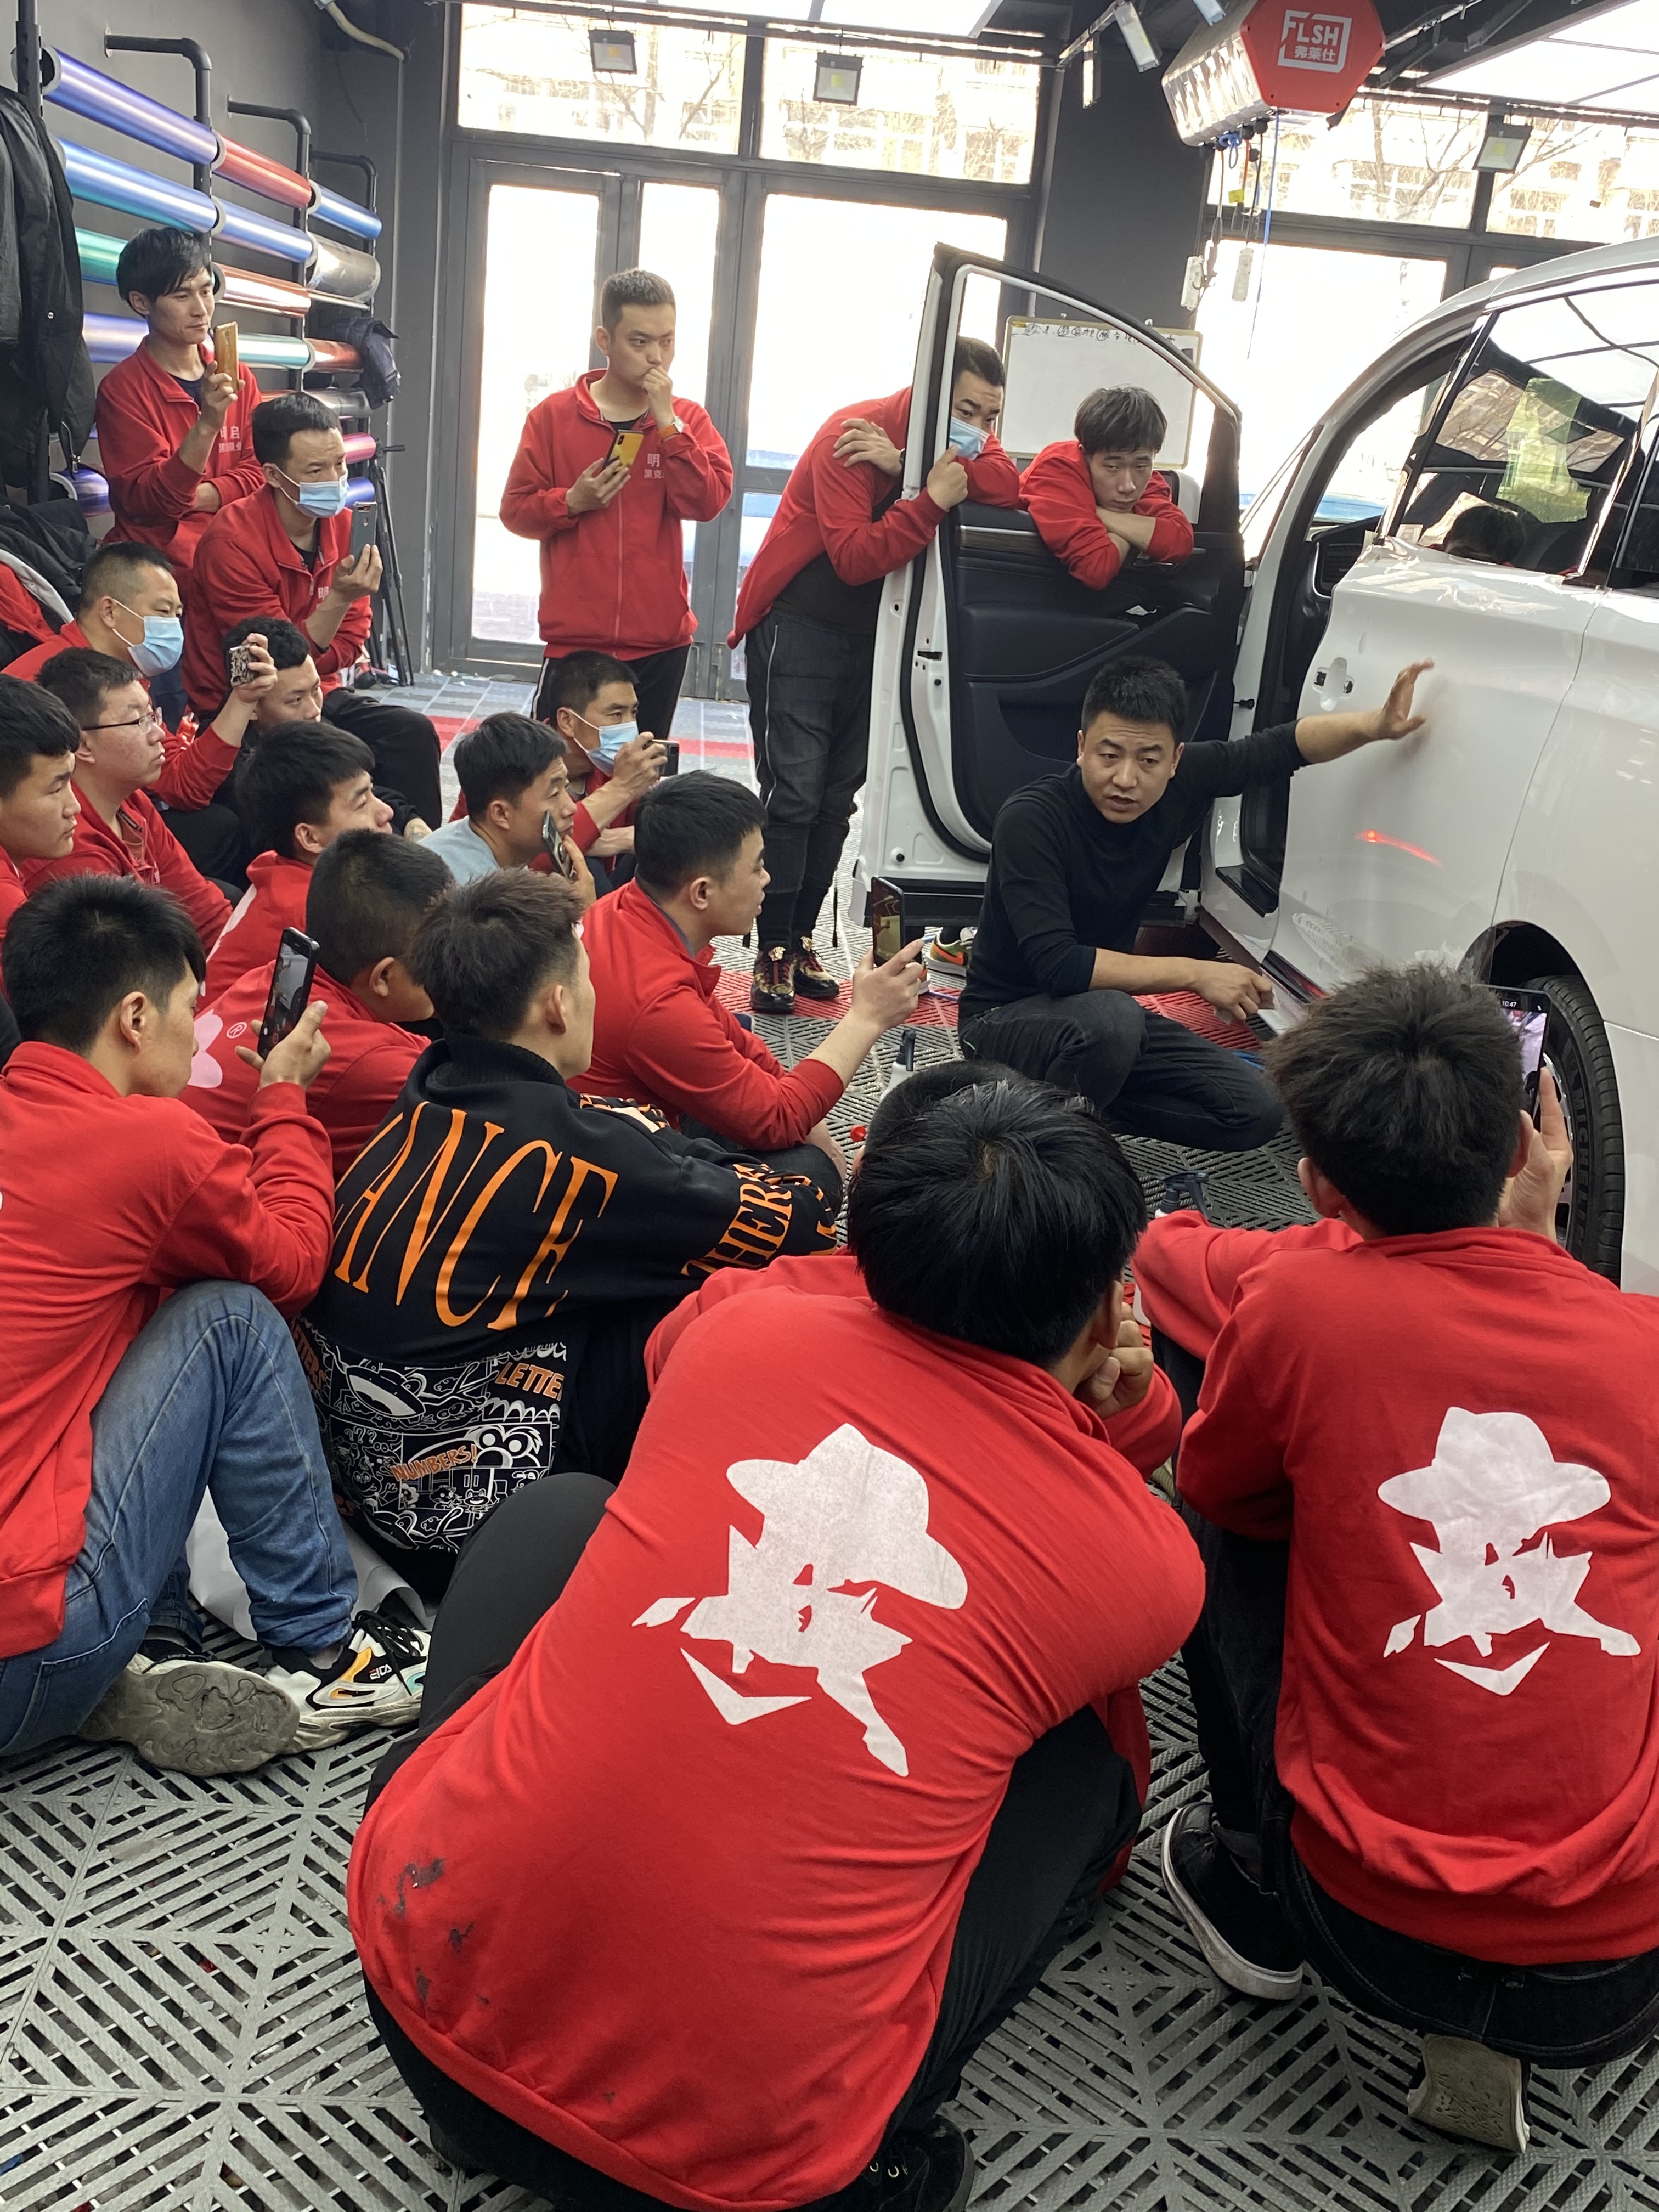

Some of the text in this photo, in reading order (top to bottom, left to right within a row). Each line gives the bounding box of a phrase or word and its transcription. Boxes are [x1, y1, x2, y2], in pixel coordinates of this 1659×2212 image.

[1283, 13, 1340, 47] FLSH
[1294, 44, 1336, 63] 弗莱仕
[647, 453, 660, 467] 明
[1571, 1087, 1590, 1247] MICHELIN
[332, 1101, 619, 1331] ANCE
[494, 1362, 565, 1401] LETTE
[389, 1443, 477, 1482] NUMBERS!
